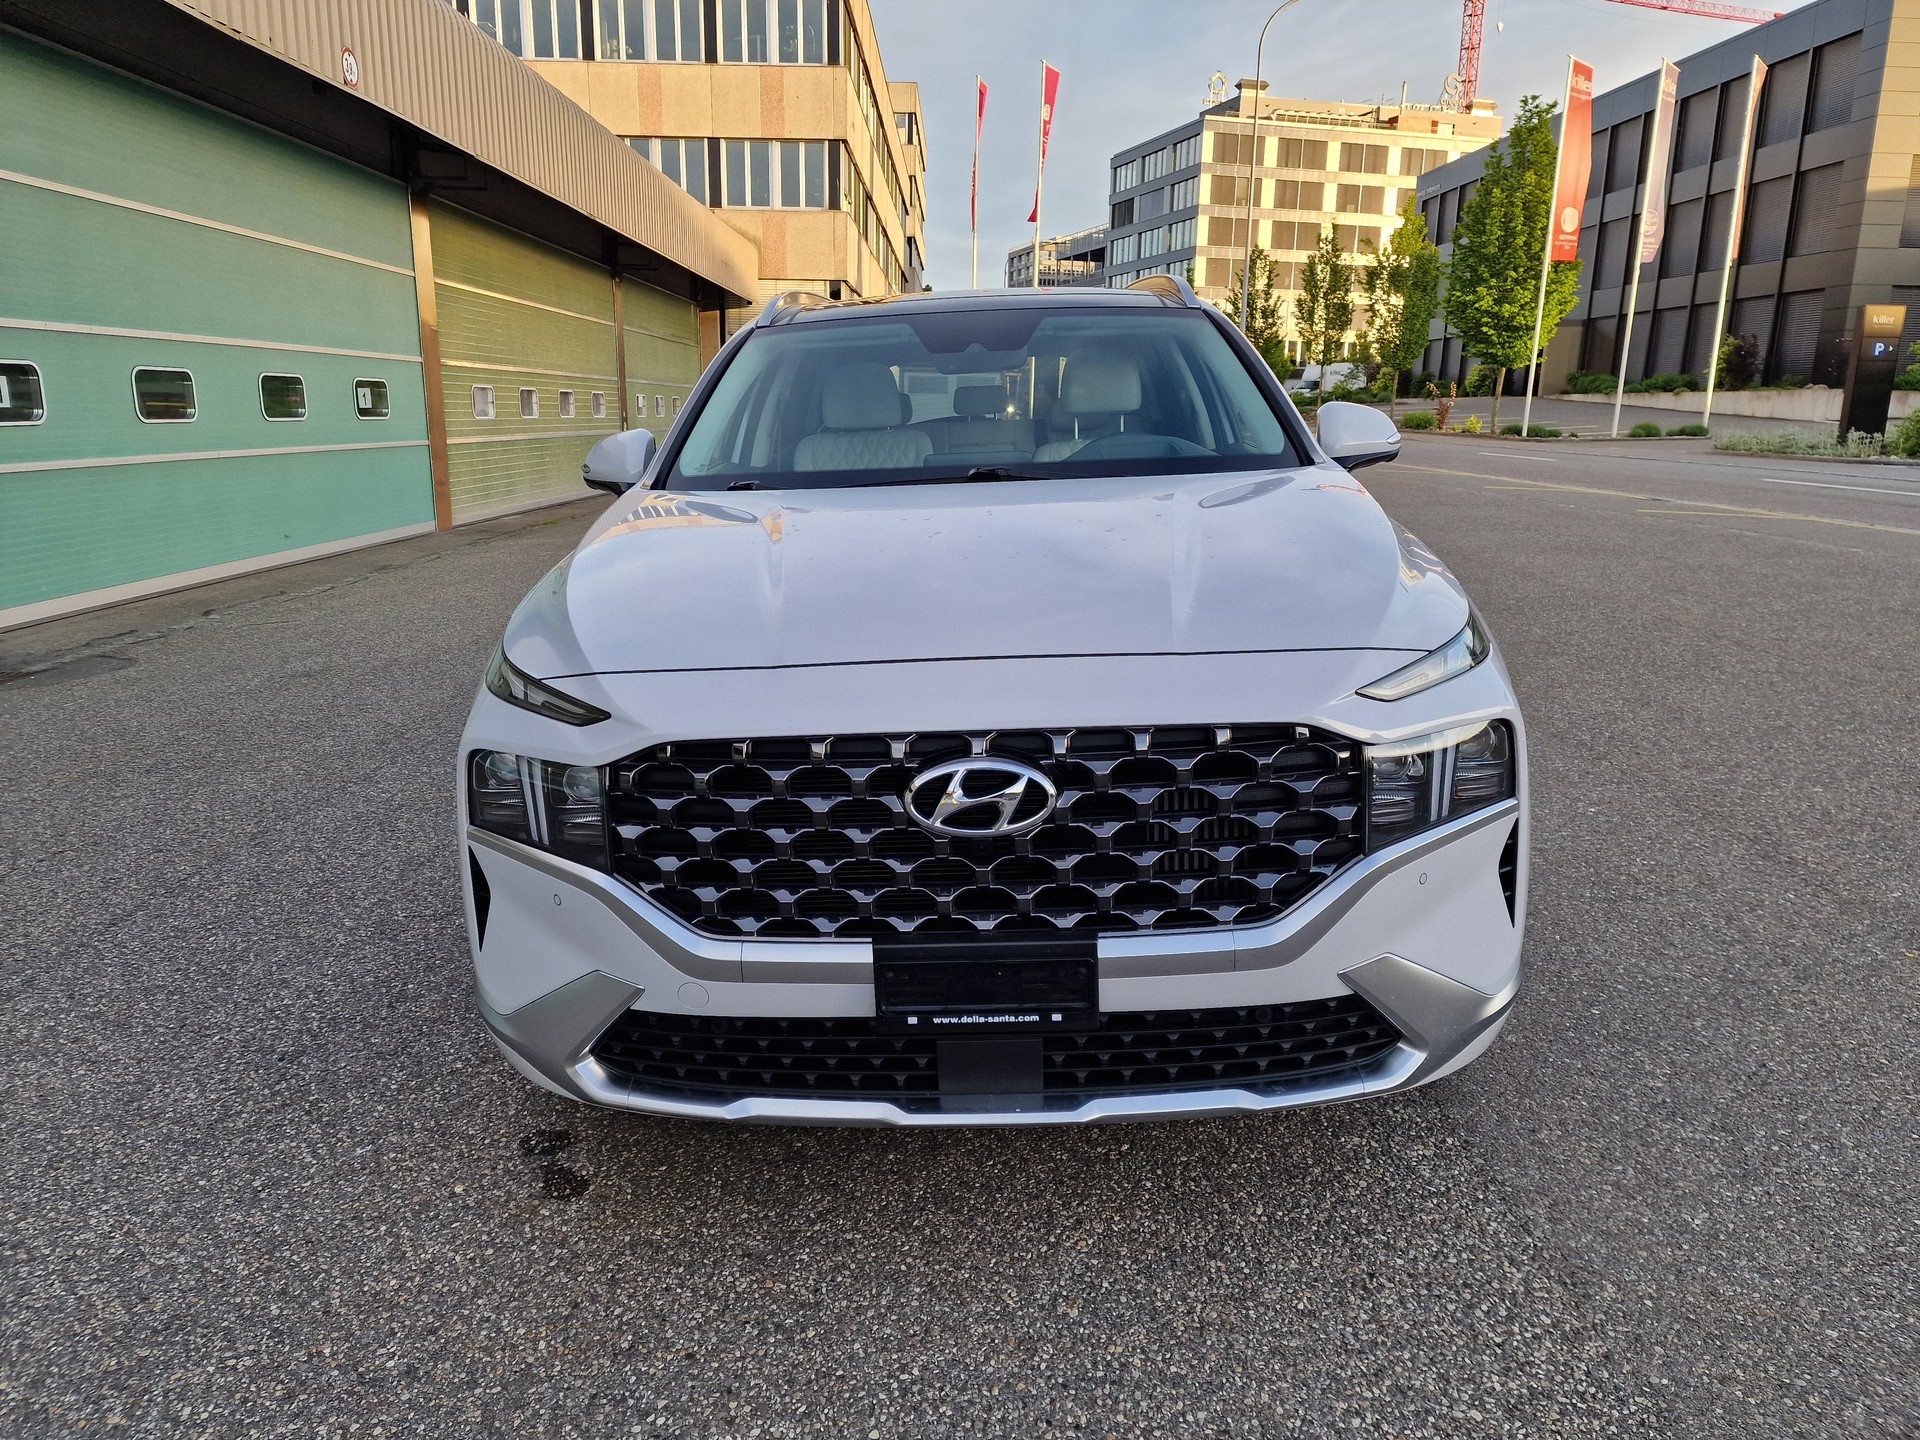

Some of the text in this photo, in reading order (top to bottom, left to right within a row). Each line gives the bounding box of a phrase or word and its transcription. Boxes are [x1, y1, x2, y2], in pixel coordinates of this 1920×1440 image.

[1873, 315, 1896, 324] killer
[1874, 343, 1885, 355] P
[933, 1015, 1039, 1024] www.della-santa.com
